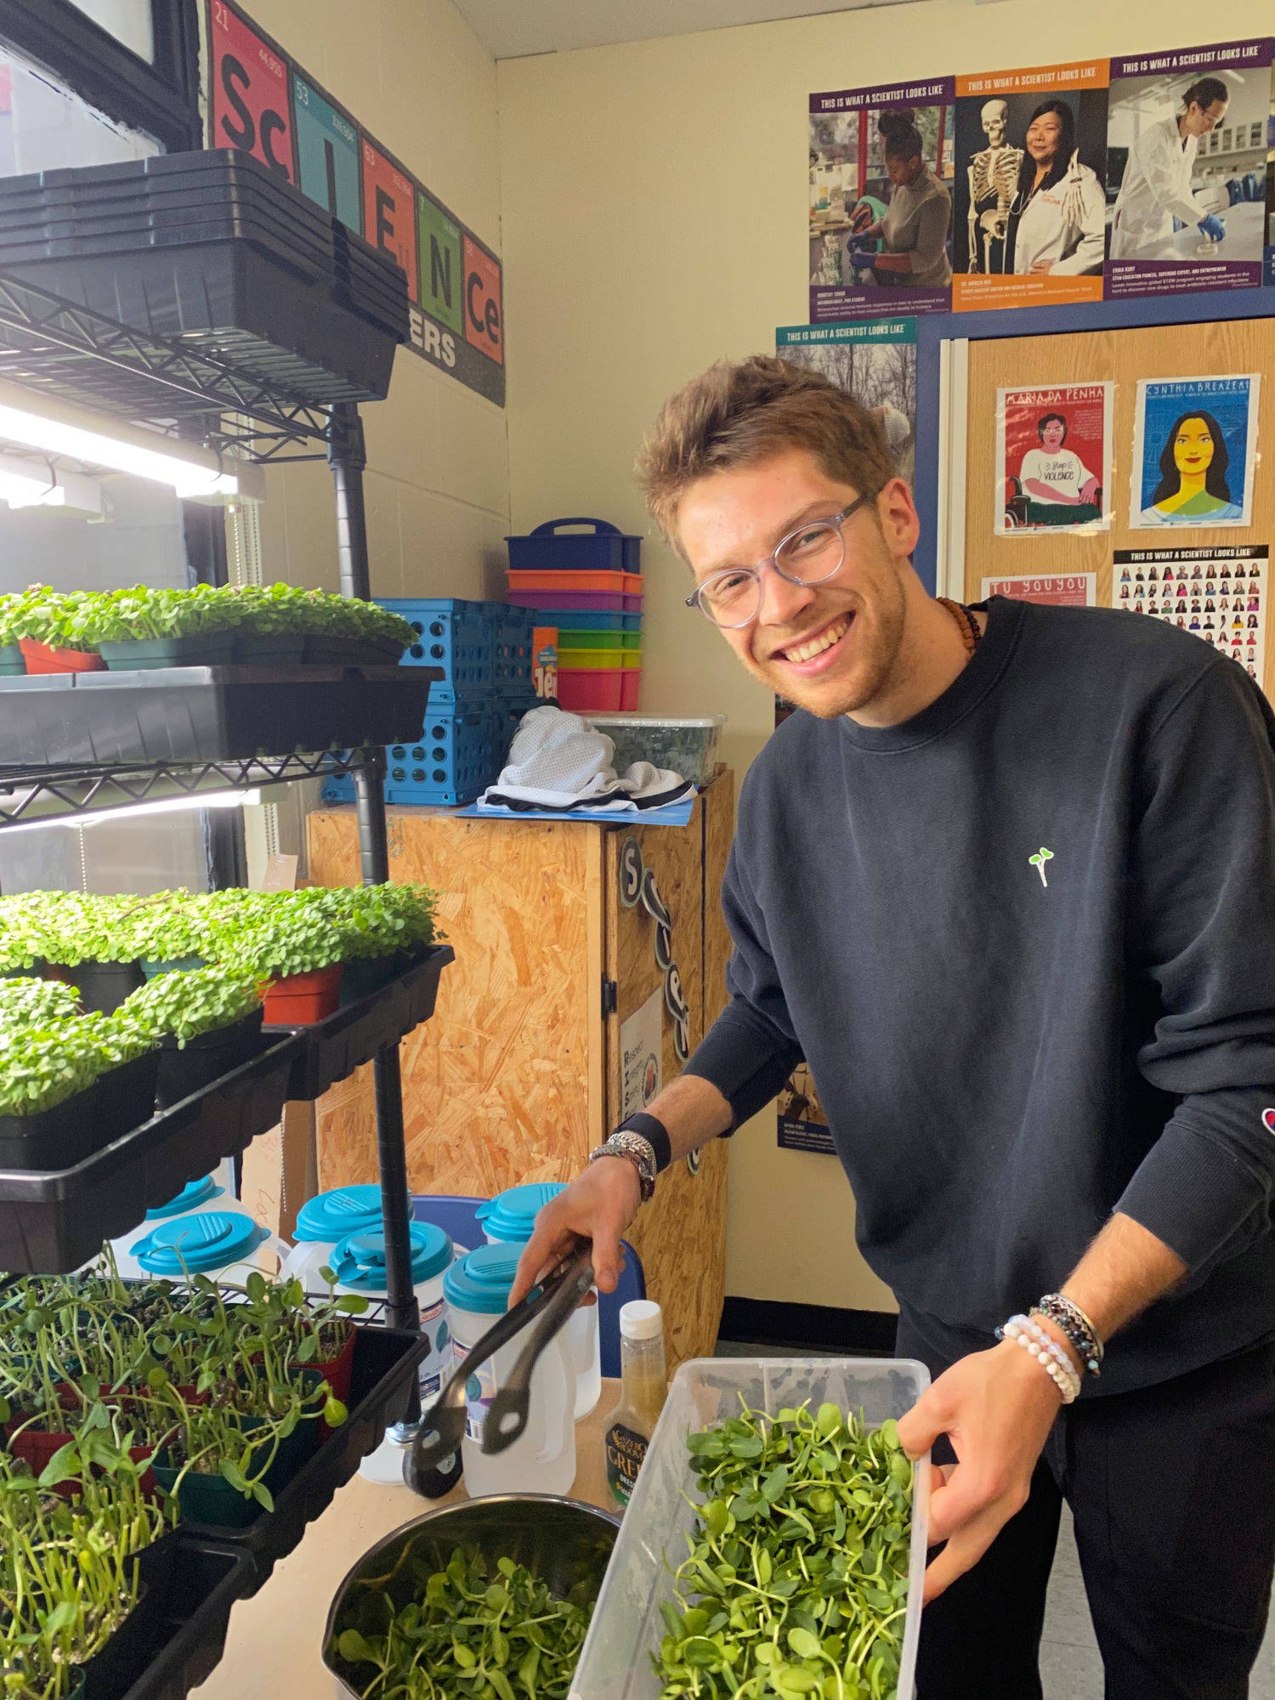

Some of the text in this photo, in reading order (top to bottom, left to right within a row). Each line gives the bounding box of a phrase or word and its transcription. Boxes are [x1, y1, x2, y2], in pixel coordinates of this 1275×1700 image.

[215, 1, 229, 31] 21
[1123, 46, 1258, 73] THIS IS WHAT A SCIENTIST LOOKS LIKE
[968, 67, 1096, 91] THIS IS WHAT A SCIENTIST LOOKS LIKE
[821, 85, 942, 109] THIS IS WHAT A SCIENTIST LOOKS LIKE
[787, 324, 904, 341] THIS IS WHAT A SCIENTIST LOOKS LIKE
[1006, 391, 1044, 404] MARIA
[1048, 391, 1061, 401] DA
[1066, 387, 1104, 400] PENHA
[1146, 384, 1194, 395] CYNTHIA
[1044, 471, 1075, 481] VIOLENCE
[1131, 548, 1250, 561] THIS IS WHAT A SCIENTIST LOOKS LIKE
[991, 581, 1011, 594] TU
